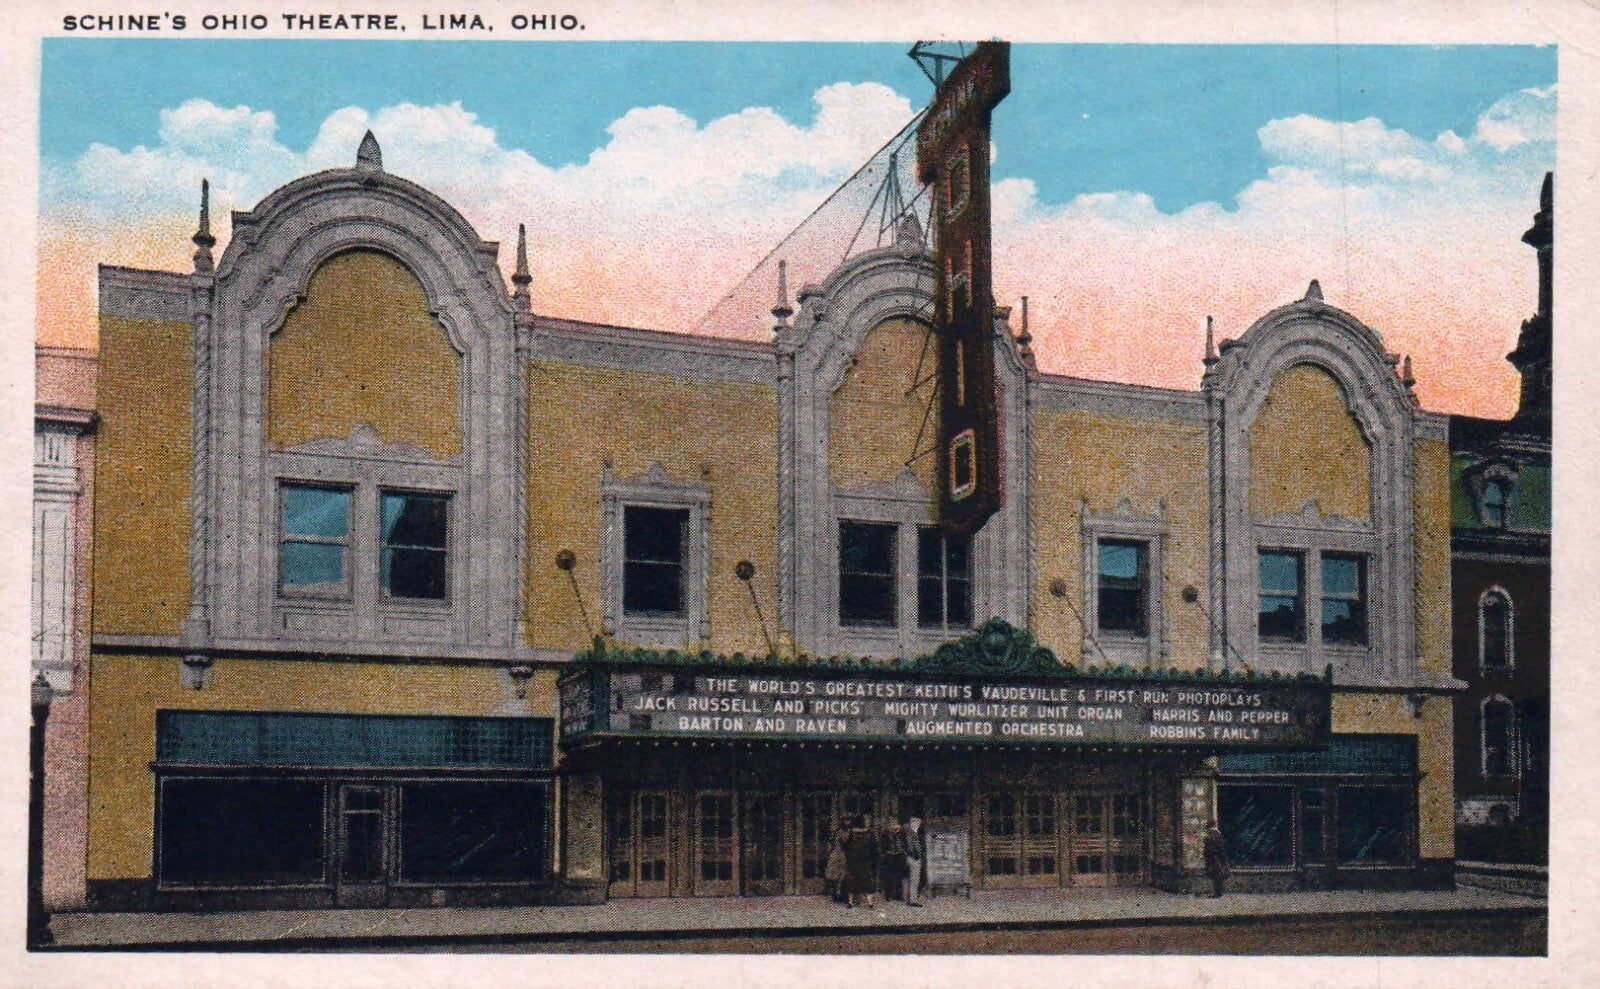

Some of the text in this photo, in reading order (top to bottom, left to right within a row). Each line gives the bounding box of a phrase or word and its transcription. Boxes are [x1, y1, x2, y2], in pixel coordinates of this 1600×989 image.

[706, 678, 737, 692] THE
[749, 680, 815, 695] WORLD'S
[825, 682, 903, 697] GREATEST
[981, 686, 1068, 701] VAUDEVILLE
[1078, 689, 1086, 701] &
[1095, 690, 1134, 703] FIRST
[1143, 691, 1169, 704] RUN
[1177, 692, 1262, 707] PHOTOPLAYS
[634, 697, 676, 711] JACK
[687, 698, 762, 713] RUSSELL
[773, 700, 804, 714] AND
[884, 702, 1122, 720] MIGHTY WURLITZER UNIT ORGAN
[680, 716, 847, 733] BARTON AND RAVEN
[1152, 709, 1289, 724] HARRIS AND PEPPER
[906, 721, 1084, 737] AUGMENTED ORCHESTRA
[1150, 725, 1260, 740] ROBBINS FAMILY
